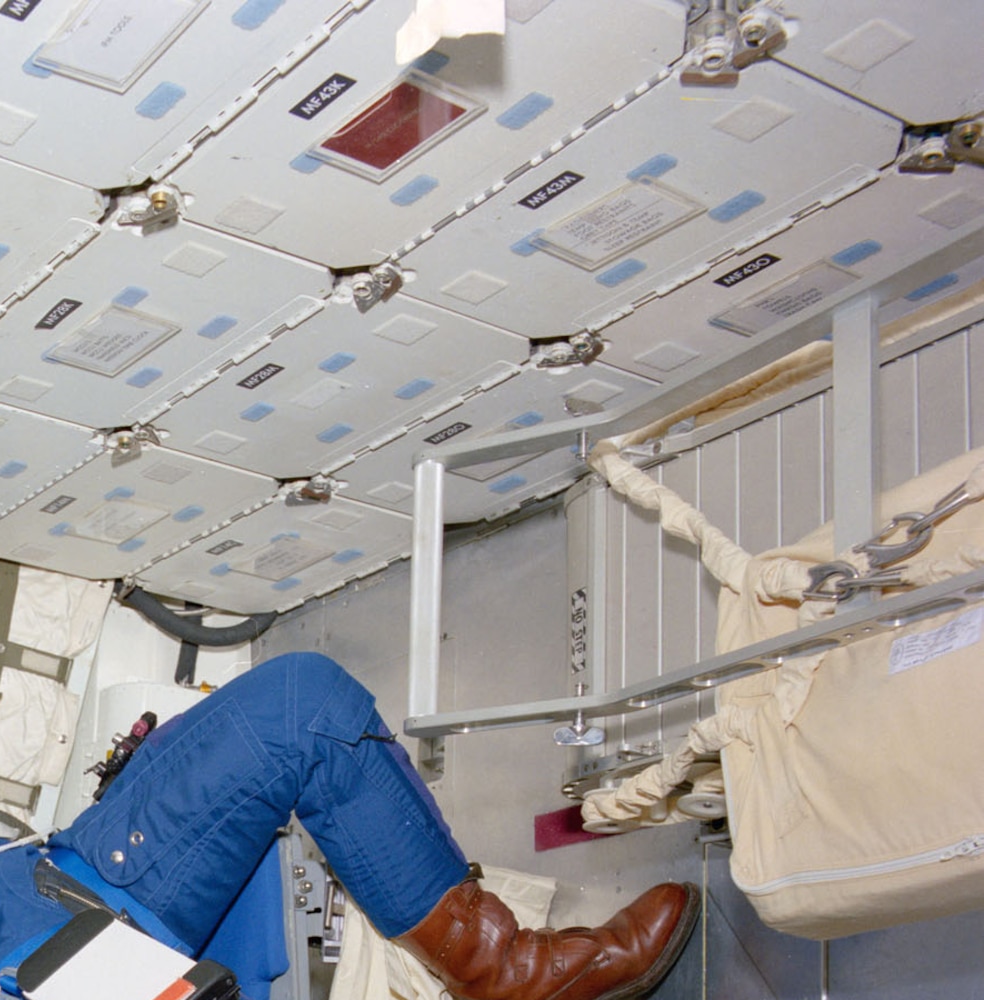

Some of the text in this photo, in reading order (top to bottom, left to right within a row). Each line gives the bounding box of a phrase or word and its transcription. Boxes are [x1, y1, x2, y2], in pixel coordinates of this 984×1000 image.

[300, 80, 347, 114] MF43K
[528, 175, 577, 207] MF43M
[44, 302, 73, 325] MF28K
[575, 608, 583, 655] NO STEP
